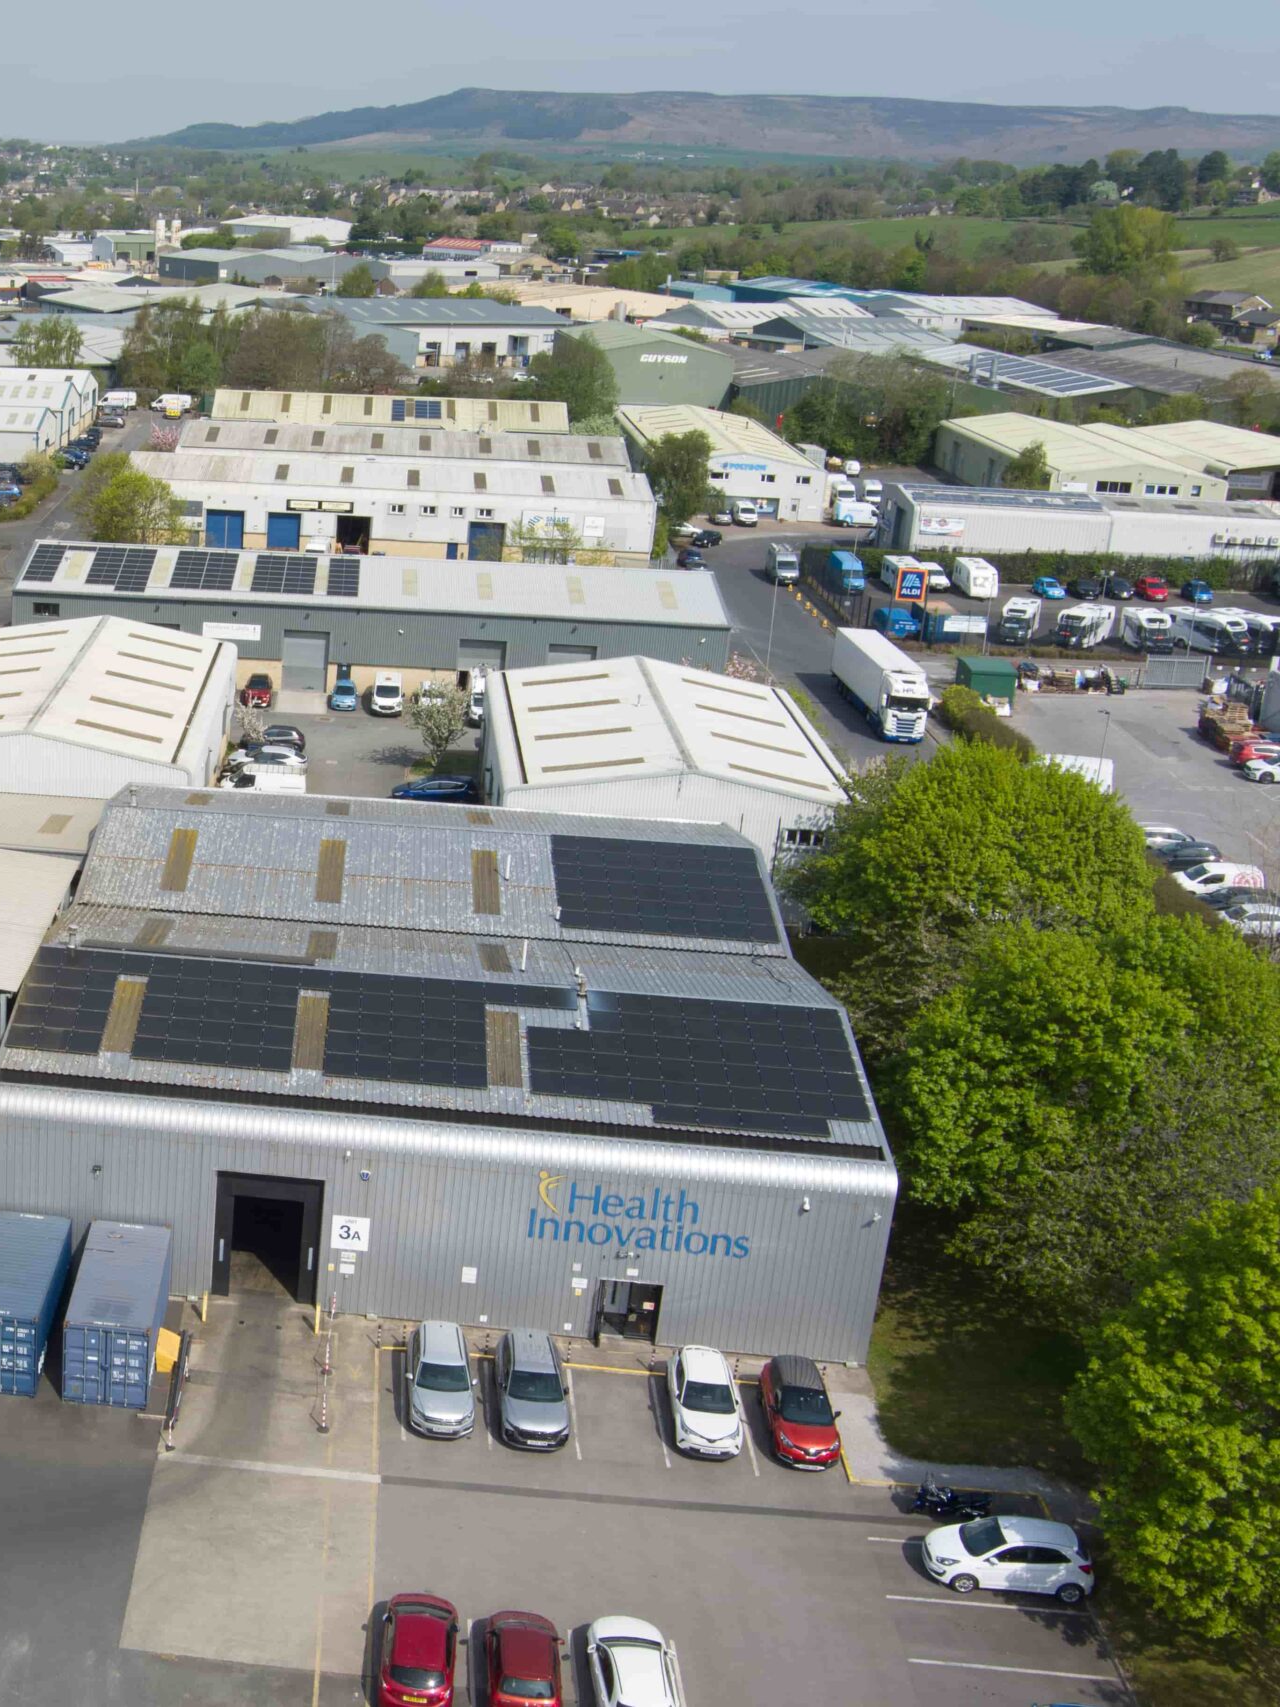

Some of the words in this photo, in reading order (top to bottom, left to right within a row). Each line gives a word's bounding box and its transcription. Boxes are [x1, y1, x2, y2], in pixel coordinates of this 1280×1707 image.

[640, 354, 688, 363] GUYSON
[568, 1181, 699, 1225] Health
[339, 1225, 361, 1240] 3A
[527, 1208, 749, 1259] Innovations
